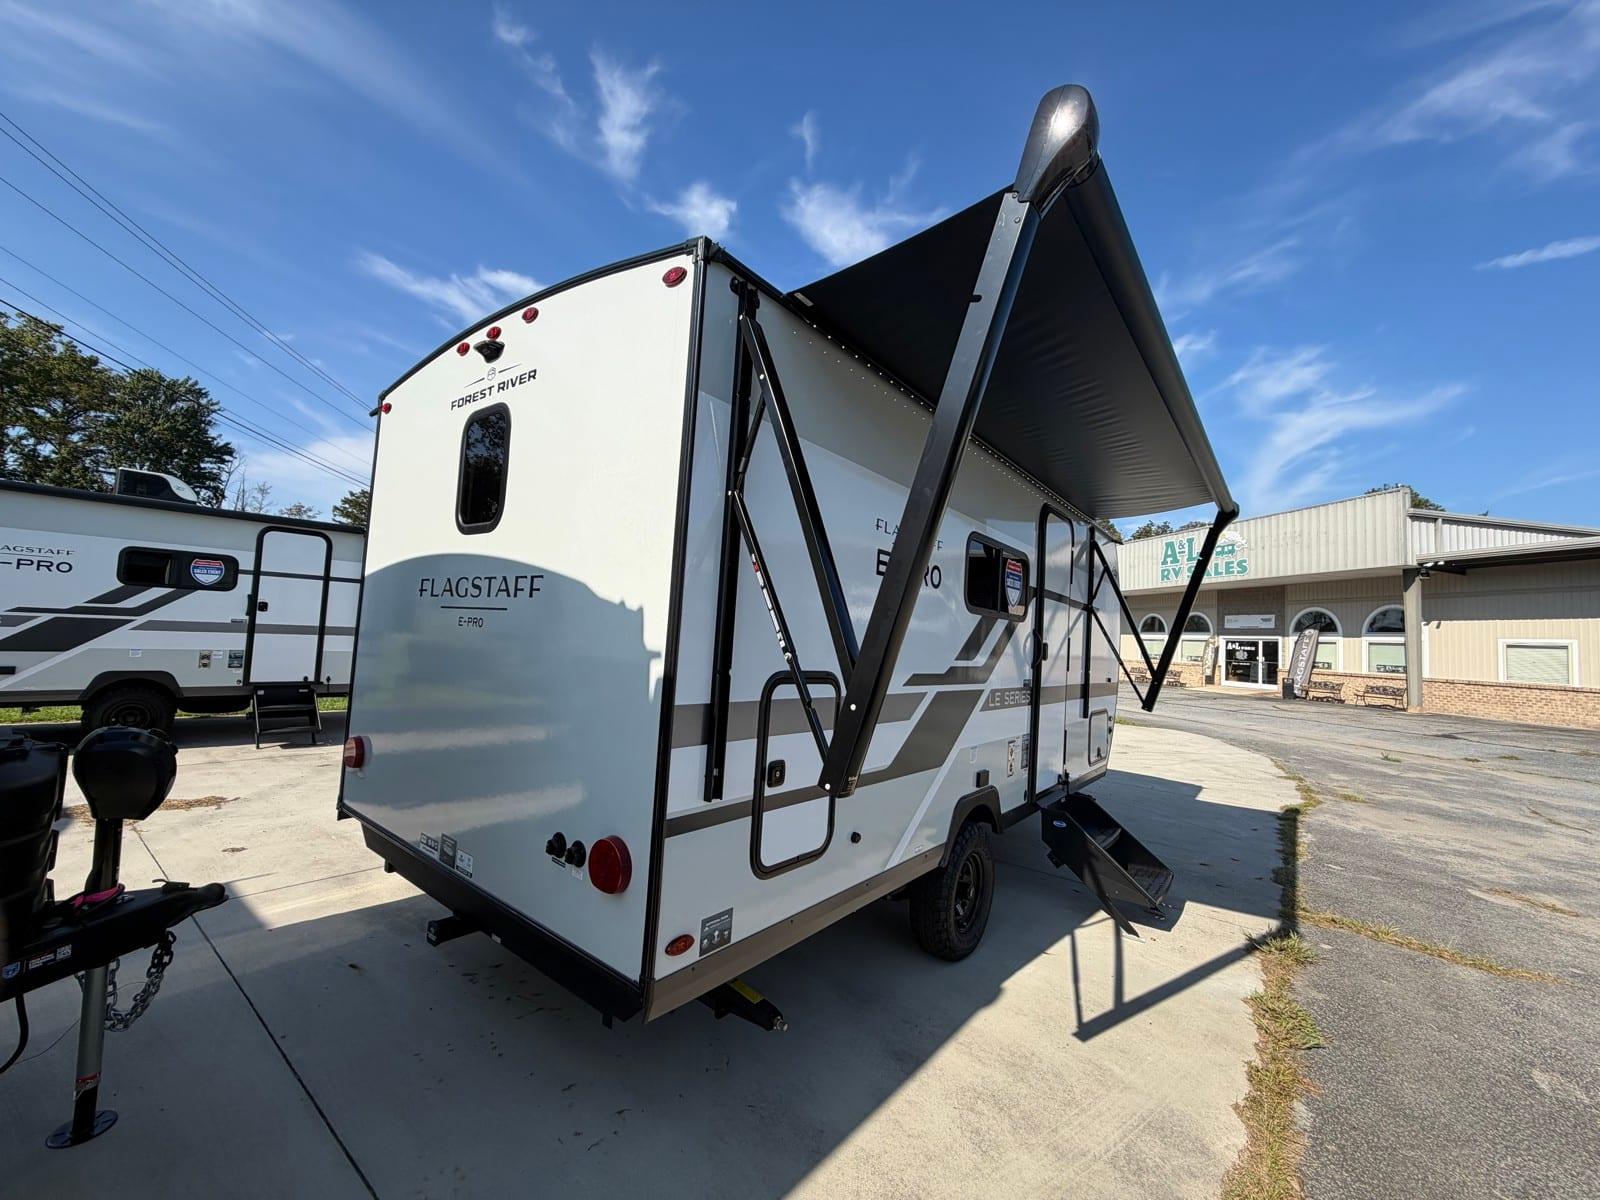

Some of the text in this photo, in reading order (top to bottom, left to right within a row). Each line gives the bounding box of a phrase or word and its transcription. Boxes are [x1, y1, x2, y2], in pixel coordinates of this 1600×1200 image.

[451, 369, 537, 411] FOREST RIVER
[0, 544, 76, 556] AGSTAFF
[1161, 537, 1201, 566] A&L
[0, 558, 73, 573] -PRO
[1161, 566, 1182, 582] RV
[418, 574, 544, 598] FLAGSTAFF
[458, 616, 484, 628] E-PRO
[988, 690, 1031, 707] LE SERIES
